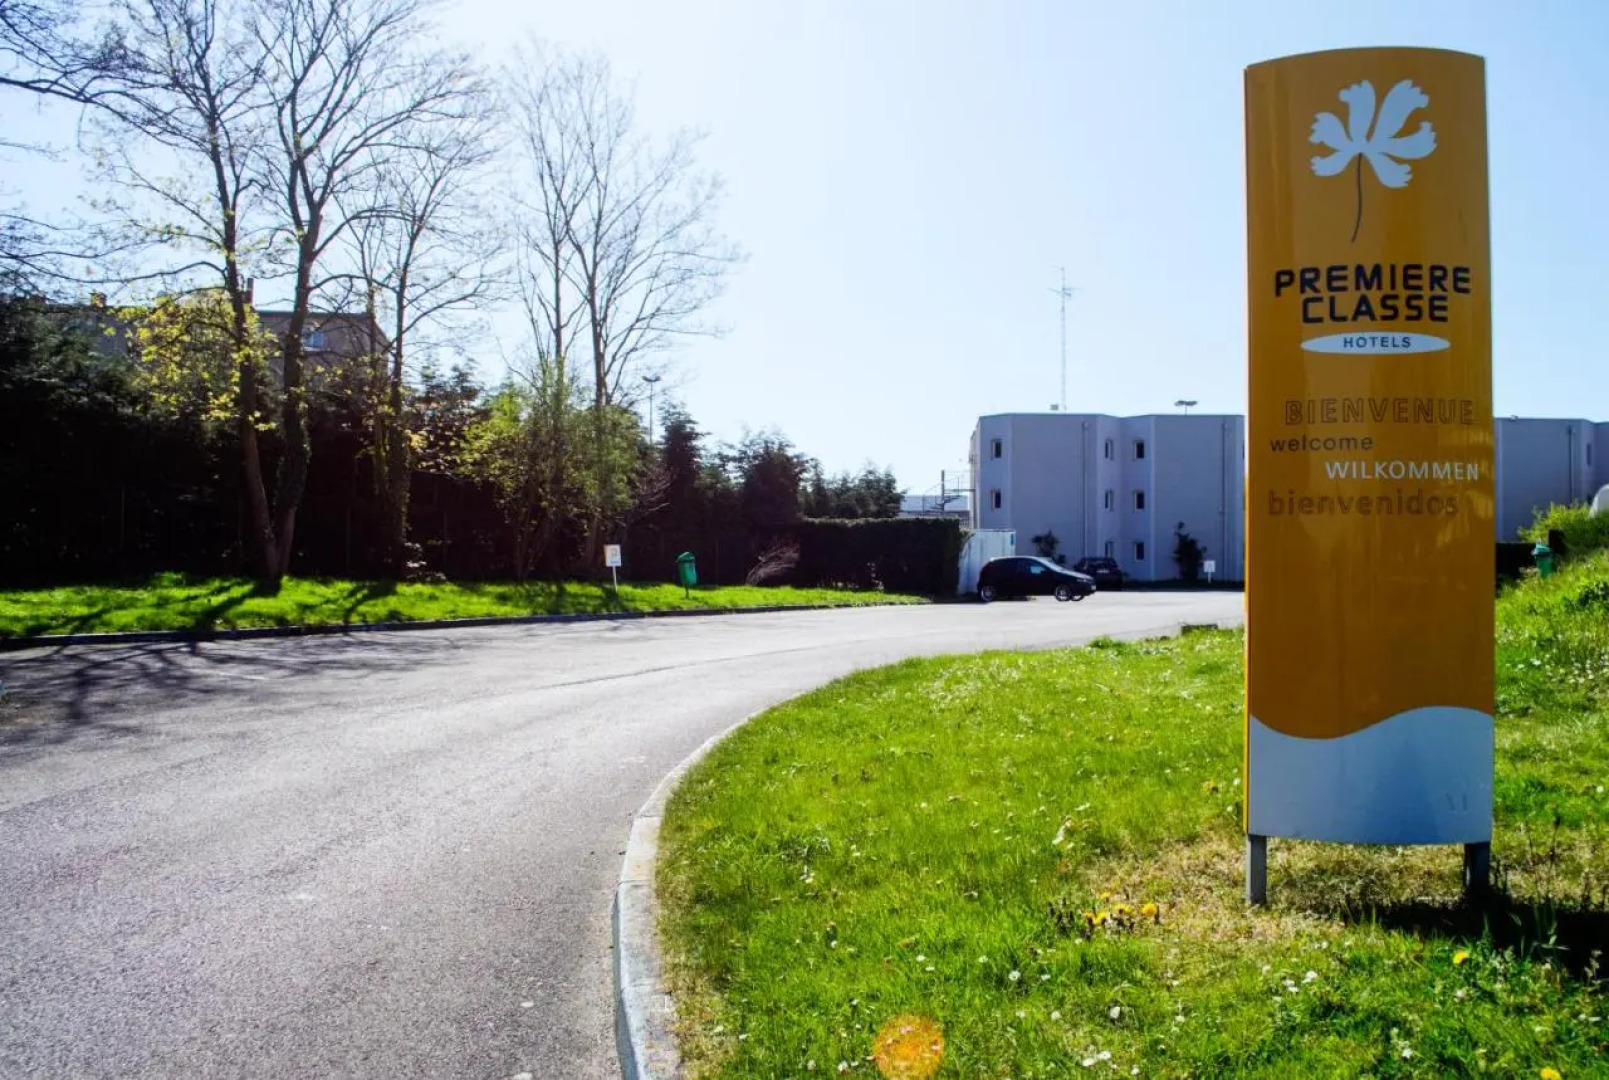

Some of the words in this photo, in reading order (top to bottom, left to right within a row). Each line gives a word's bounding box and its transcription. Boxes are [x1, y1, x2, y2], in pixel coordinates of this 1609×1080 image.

[1275, 263, 1471, 297] PREMIERE
[1302, 294, 1449, 324] CLASSE
[1343, 336, 1412, 348] HOTELS
[1285, 397, 1475, 426] BIENVENUE
[1269, 435, 1374, 452] welcome
[1325, 460, 1478, 481] WILKOMMEN
[1268, 489, 1459, 516] bienvenidos
